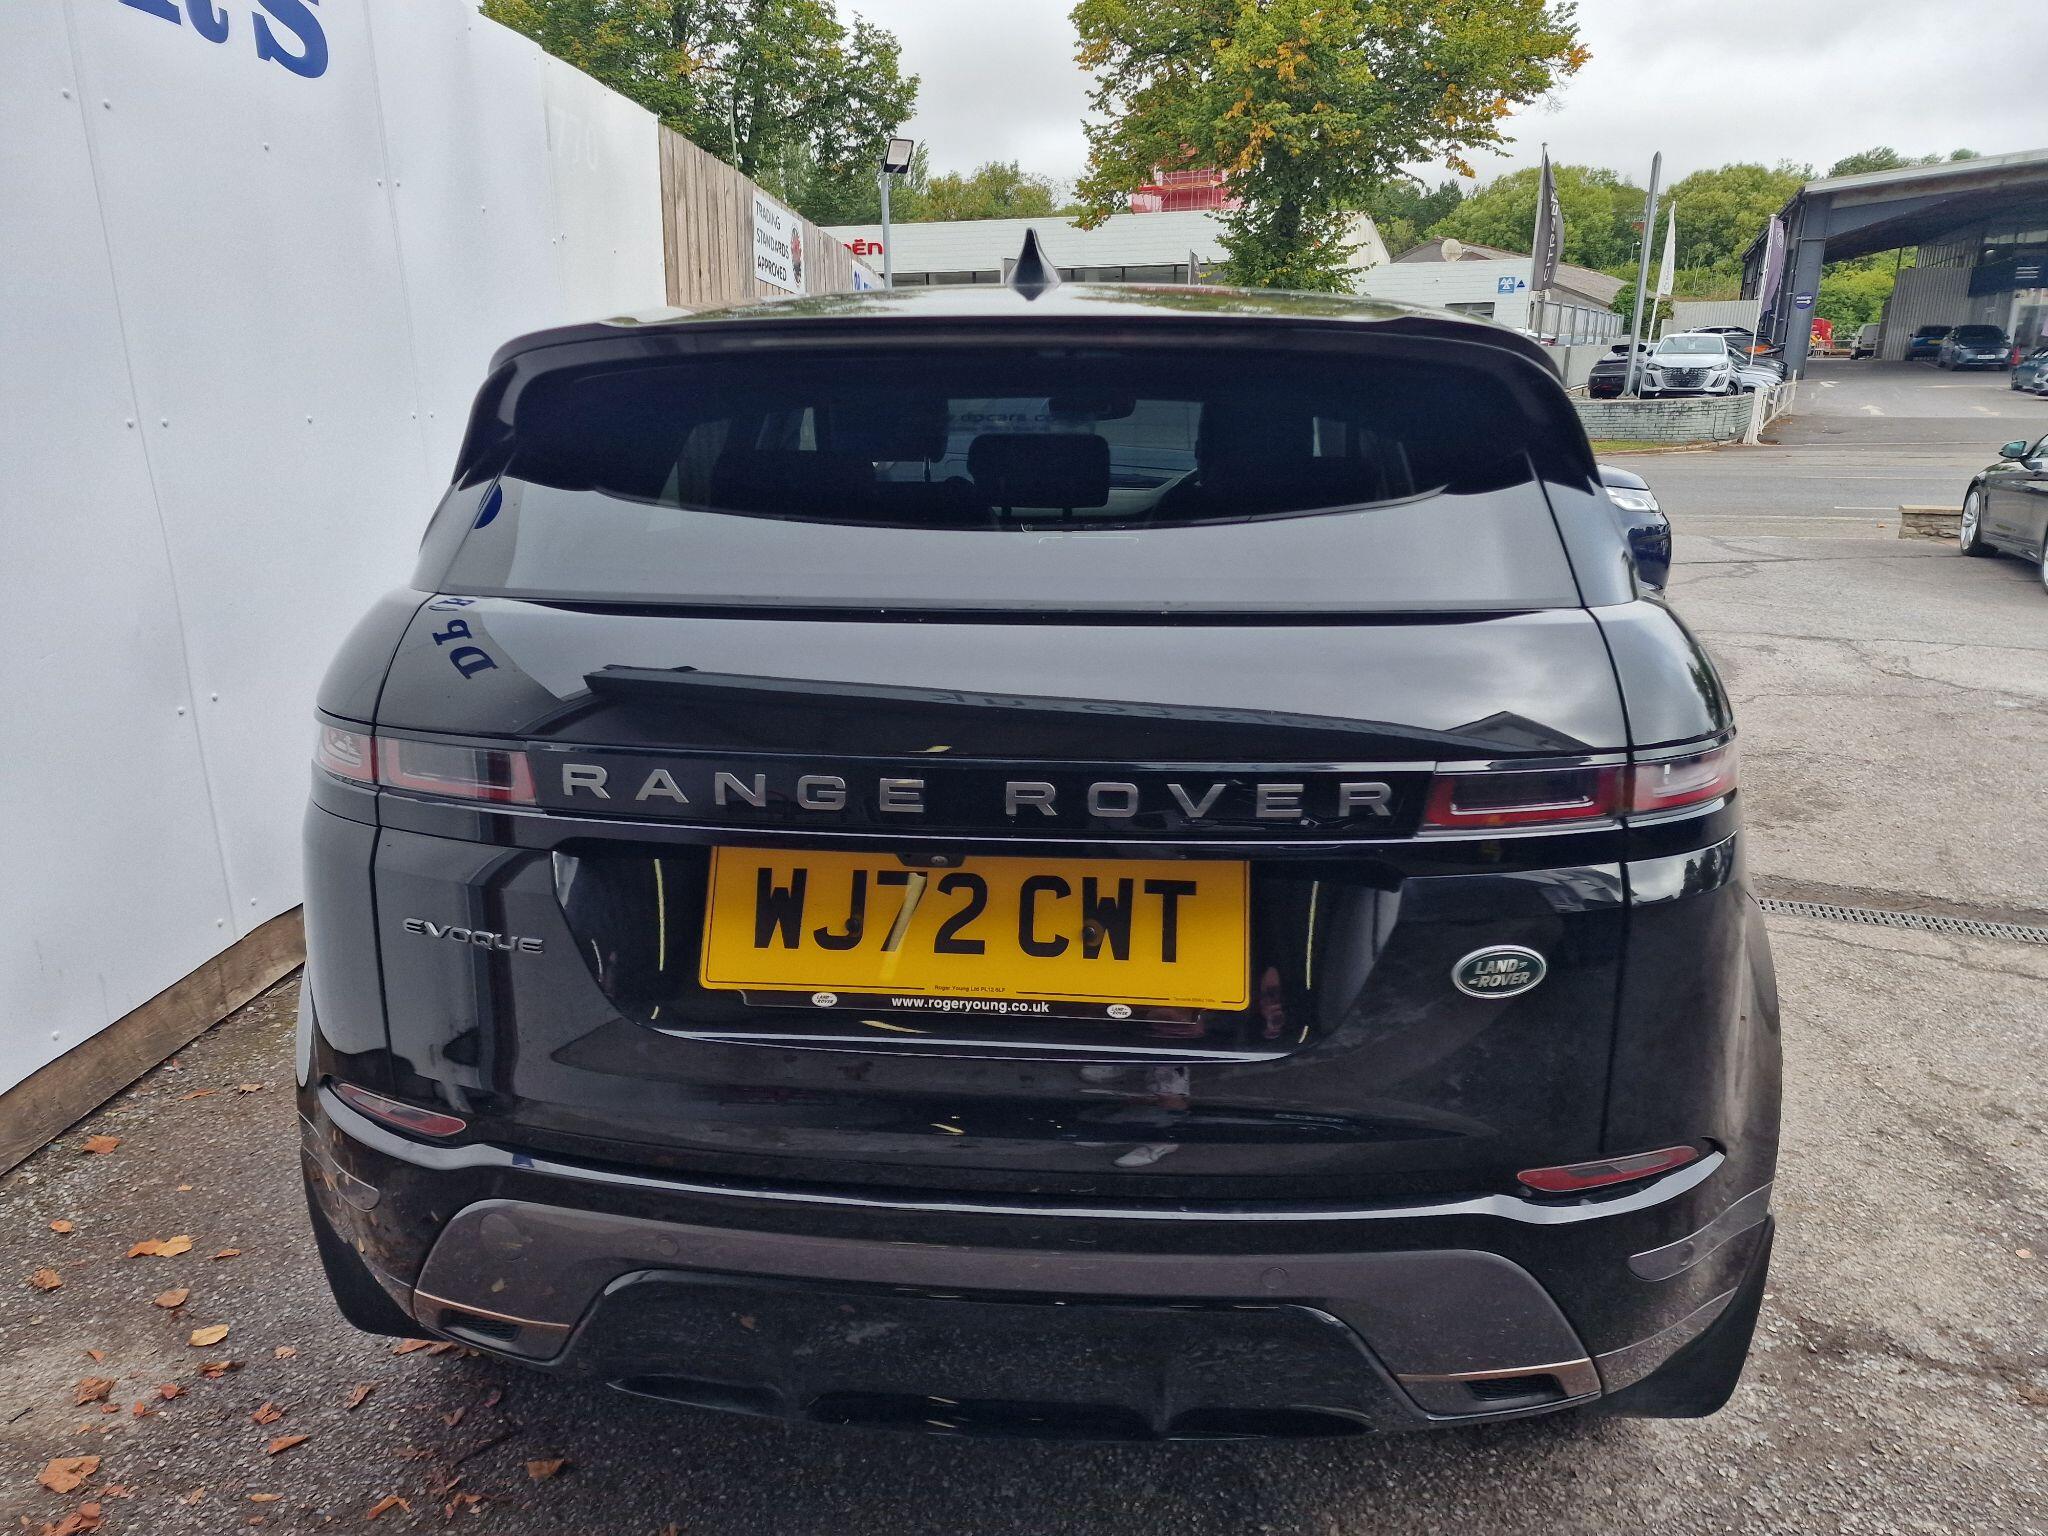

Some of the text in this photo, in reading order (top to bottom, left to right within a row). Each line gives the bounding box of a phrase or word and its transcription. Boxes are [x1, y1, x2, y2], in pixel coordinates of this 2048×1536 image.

[756, 201, 781, 231] TRADING
[756, 227, 790, 260] STANDARDS
[757, 254, 787, 281] APPROVED
[562, 763, 1392, 818] RANGE ROVER
[753, 866, 1198, 963] WJ72 CWT
[403, 917, 544, 955] EVOQUE
[934, 984, 951, 992] Roger
[952, 985, 970, 993] Young
[1477, 971, 1531, 988] ROVER
[891, 997, 1050, 1014] www.rogeryoung.co.uk
